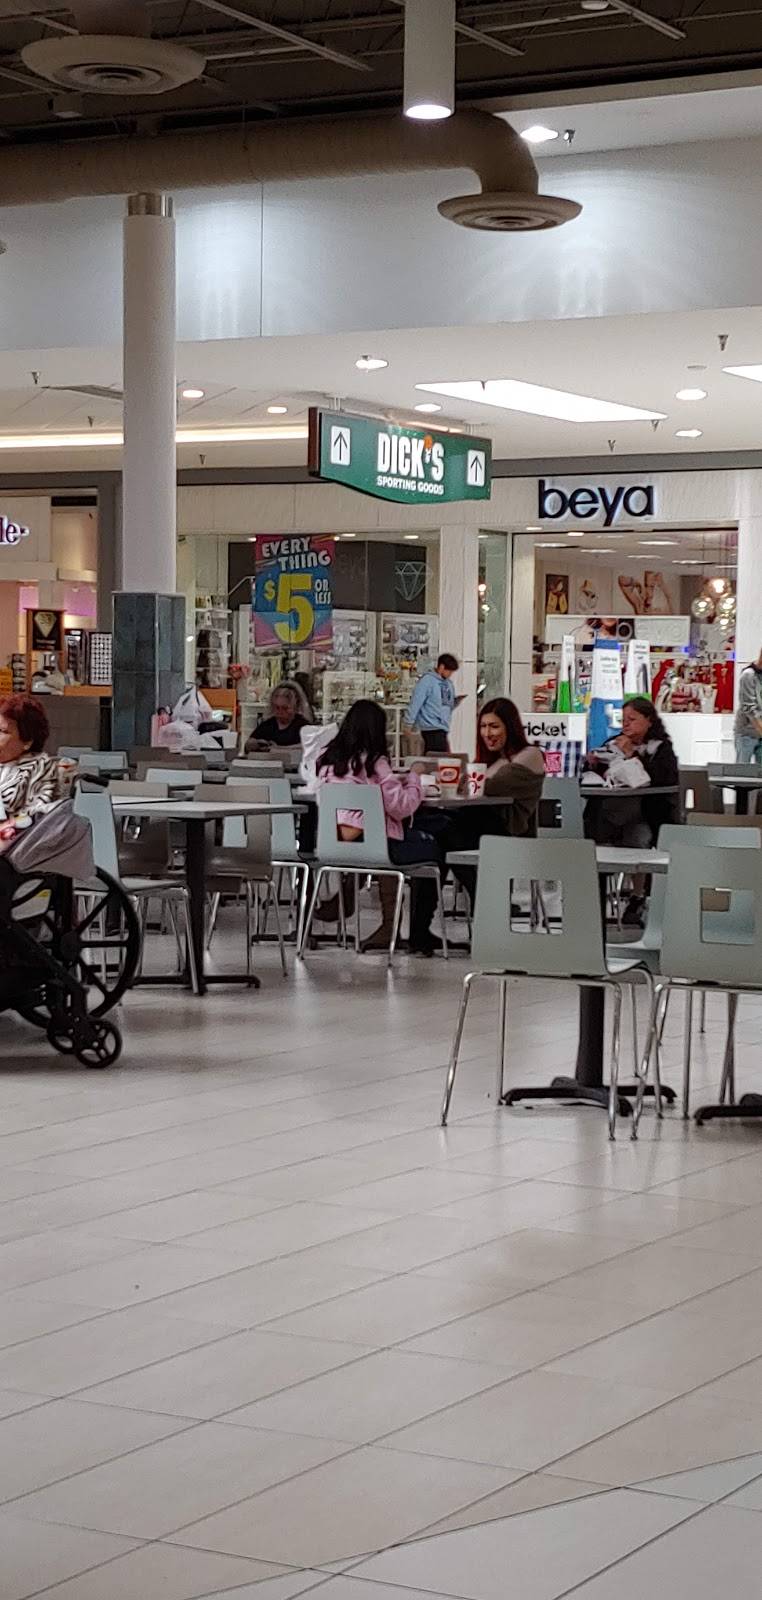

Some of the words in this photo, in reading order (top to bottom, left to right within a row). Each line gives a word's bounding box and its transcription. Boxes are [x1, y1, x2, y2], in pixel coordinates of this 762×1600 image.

[377, 432, 444, 482] DICK'S
[377, 475, 417, 491] SPORTING
[417, 481, 444, 496] GOODS
[538, 479, 654, 527] beya
[261, 536, 311, 558] EVERY
[278, 550, 331, 571] THING
[314, 578, 329, 593] OR
[315, 591, 331, 605] LESS
